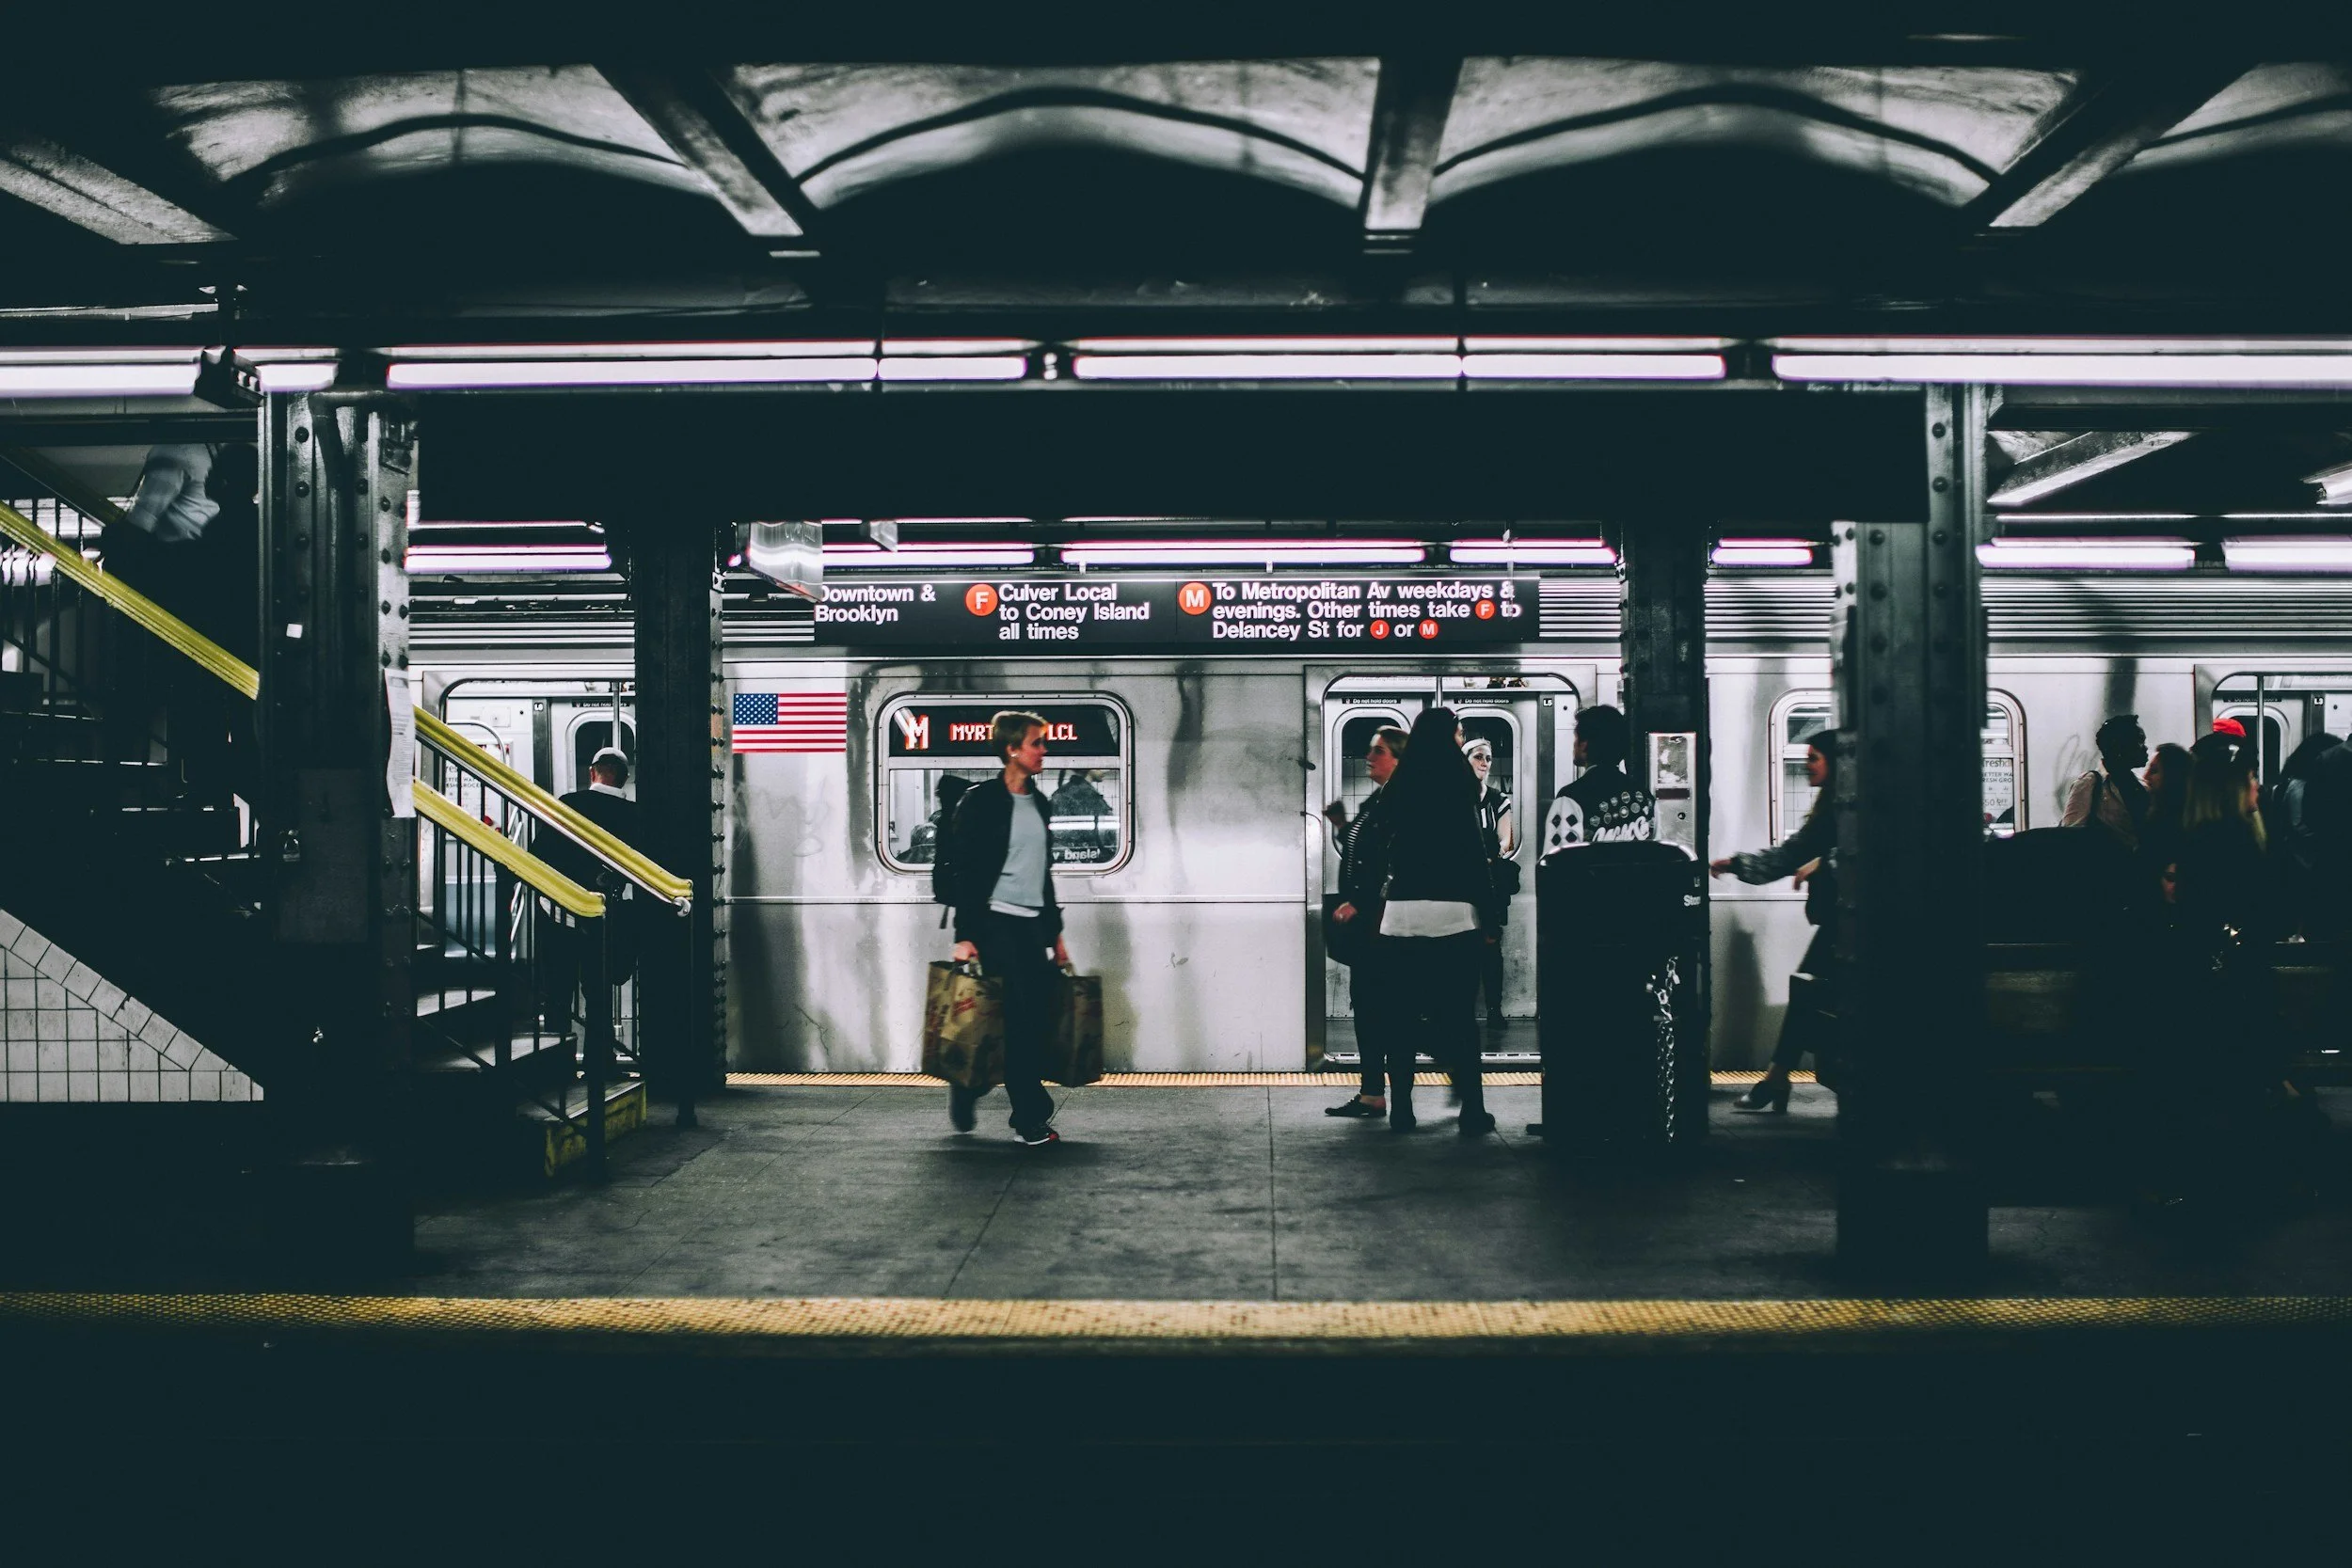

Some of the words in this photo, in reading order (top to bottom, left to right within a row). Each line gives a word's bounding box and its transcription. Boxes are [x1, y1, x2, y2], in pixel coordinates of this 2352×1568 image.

[920, 583, 936, 602] &
[998, 582, 1059, 602] Culver
[1064, 582, 1118, 601] Local
[1212, 582, 1236, 600] To
[1242, 581, 1361, 603] Metropolitan
[1366, 581, 1391, 599] Av
[1397, 580, 1494, 602] weekdays
[1500, 580, 1516, 599] &
[814, 604, 898, 626] Brooklyn
[998, 603, 1020, 621] to
[1025, 602, 1088, 624] Coney
[1093, 601, 1150, 621] Island
[1212, 601, 1301, 623] evenings.
[1307, 600, 1362, 619] Other
[1367, 600, 1421, 618] times
[1427, 600, 1471, 618] take
[1500, 599, 1522, 619] to
[998, 622, 1021, 641] all
[1026, 622, 1079, 640] times
[1212, 620, 1302, 642] Delancey
[1307, 620, 1330, 639] St
[1336, 620, 1364, 638] for
[1393, 623, 1415, 638] or
[905, 715, 930, 750] M
